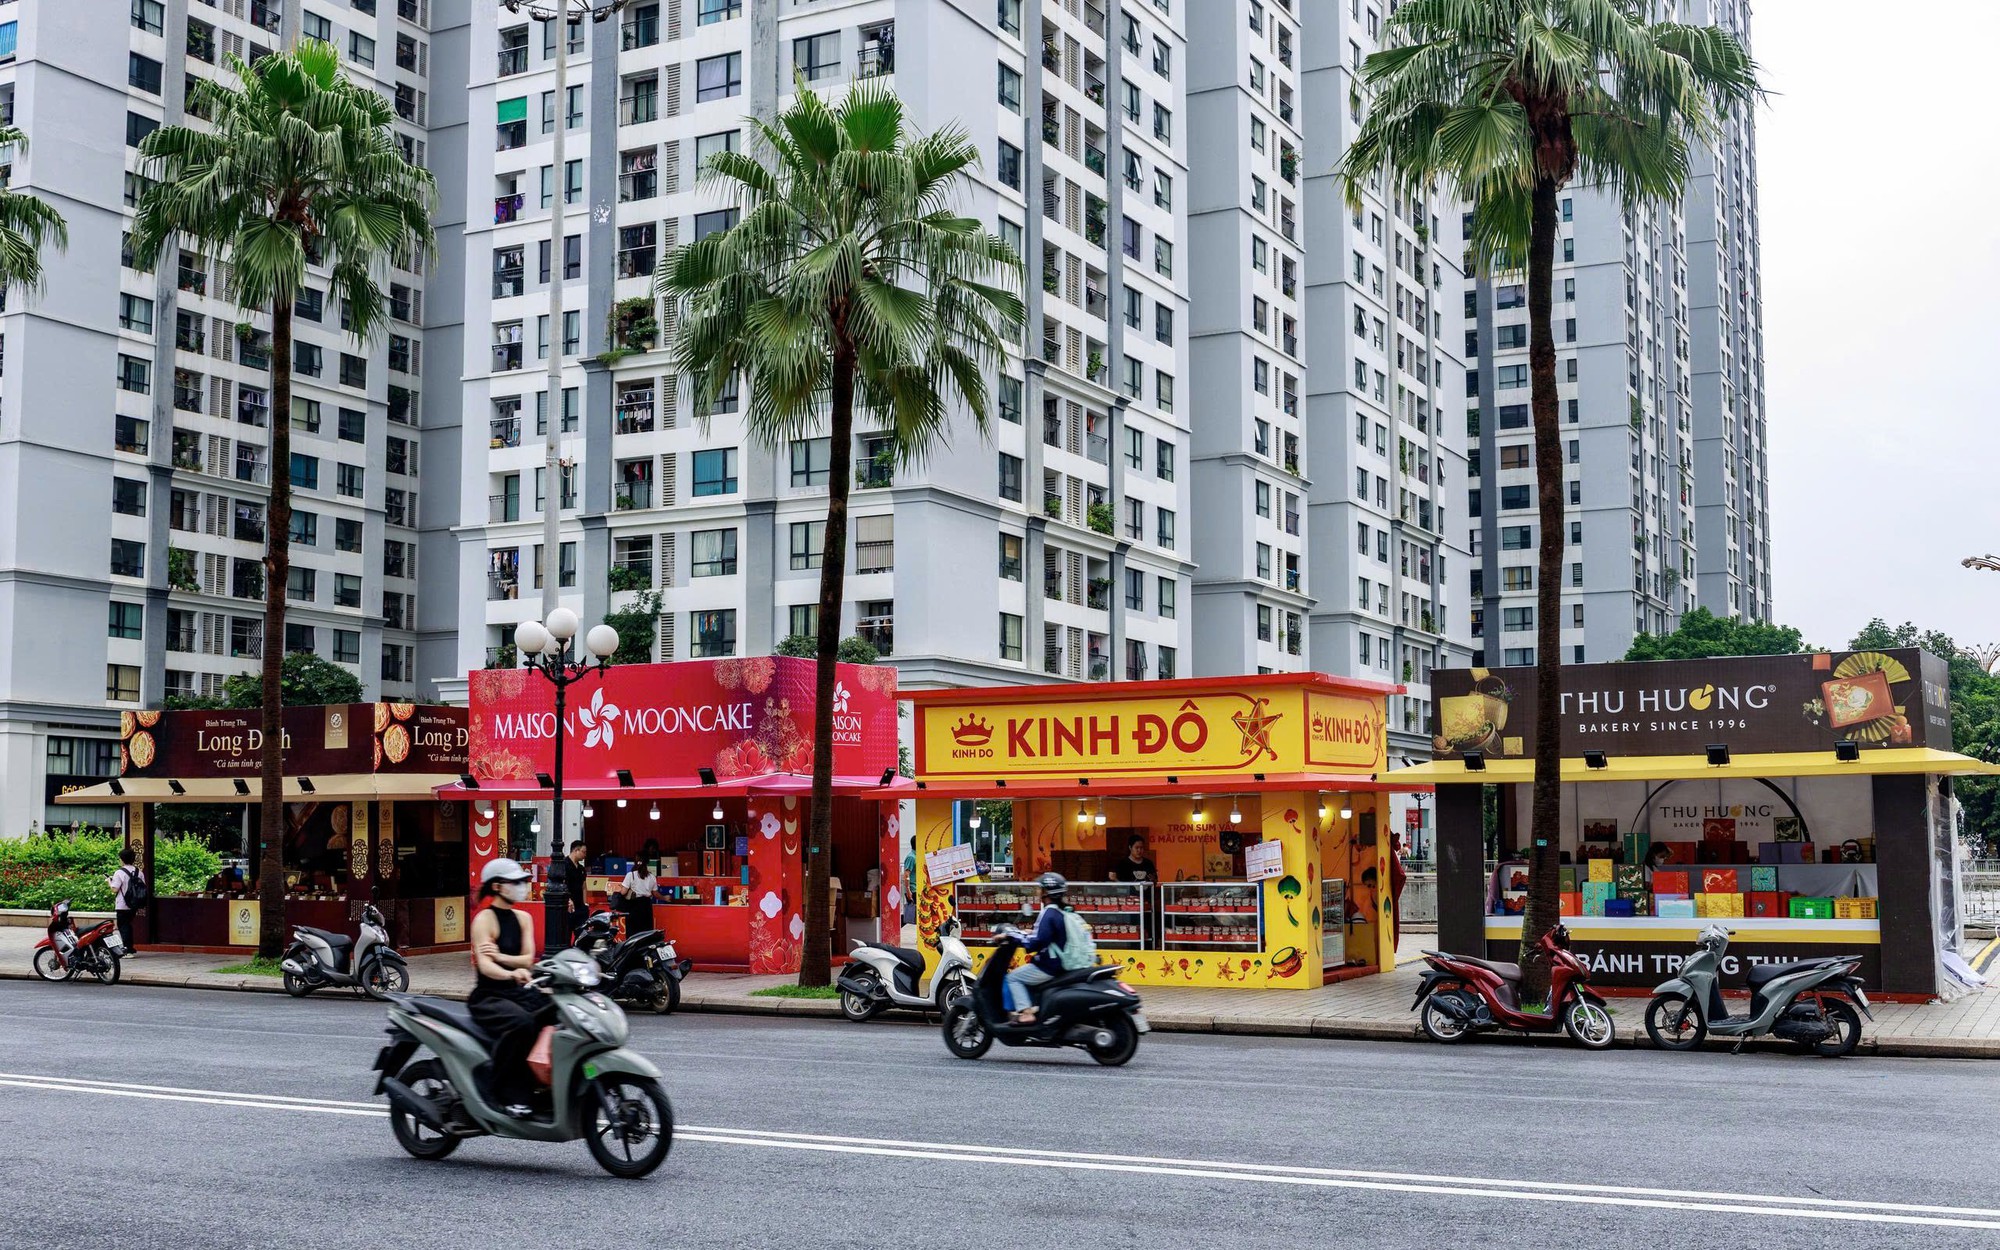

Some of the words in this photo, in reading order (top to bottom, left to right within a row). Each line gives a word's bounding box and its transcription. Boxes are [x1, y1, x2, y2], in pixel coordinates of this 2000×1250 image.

[1560, 691, 1624, 714] THU
[494, 712, 575, 739] MAISON
[623, 703, 753, 735] MOONCAKE
[832, 716, 862, 731] AISON
[1007, 715, 1120, 758] KINH
[1132, 699, 1209, 755] ĐÔ
[1324, 716, 1353, 743] KINH
[1354, 713, 1371, 745] ĐÔ
[1579, 722, 1641, 733] BAKERY
[1650, 720, 1699, 731] SINCE
[1709, 719, 1747, 729] 1996
[197, 730, 243, 757] Long
[247, 727, 292, 750] Đh
[413, 725, 453, 752] Long
[832, 731, 862, 742] ONCAKE
[952, 749, 976, 758] KINH
[978, 748, 994, 758] DO
[1660, 806, 1697, 818] THU
[1195, 823, 1217, 832] SUM
[1575, 949, 1644, 974] BÁNH
[1650, 954, 1740, 975] TRG
